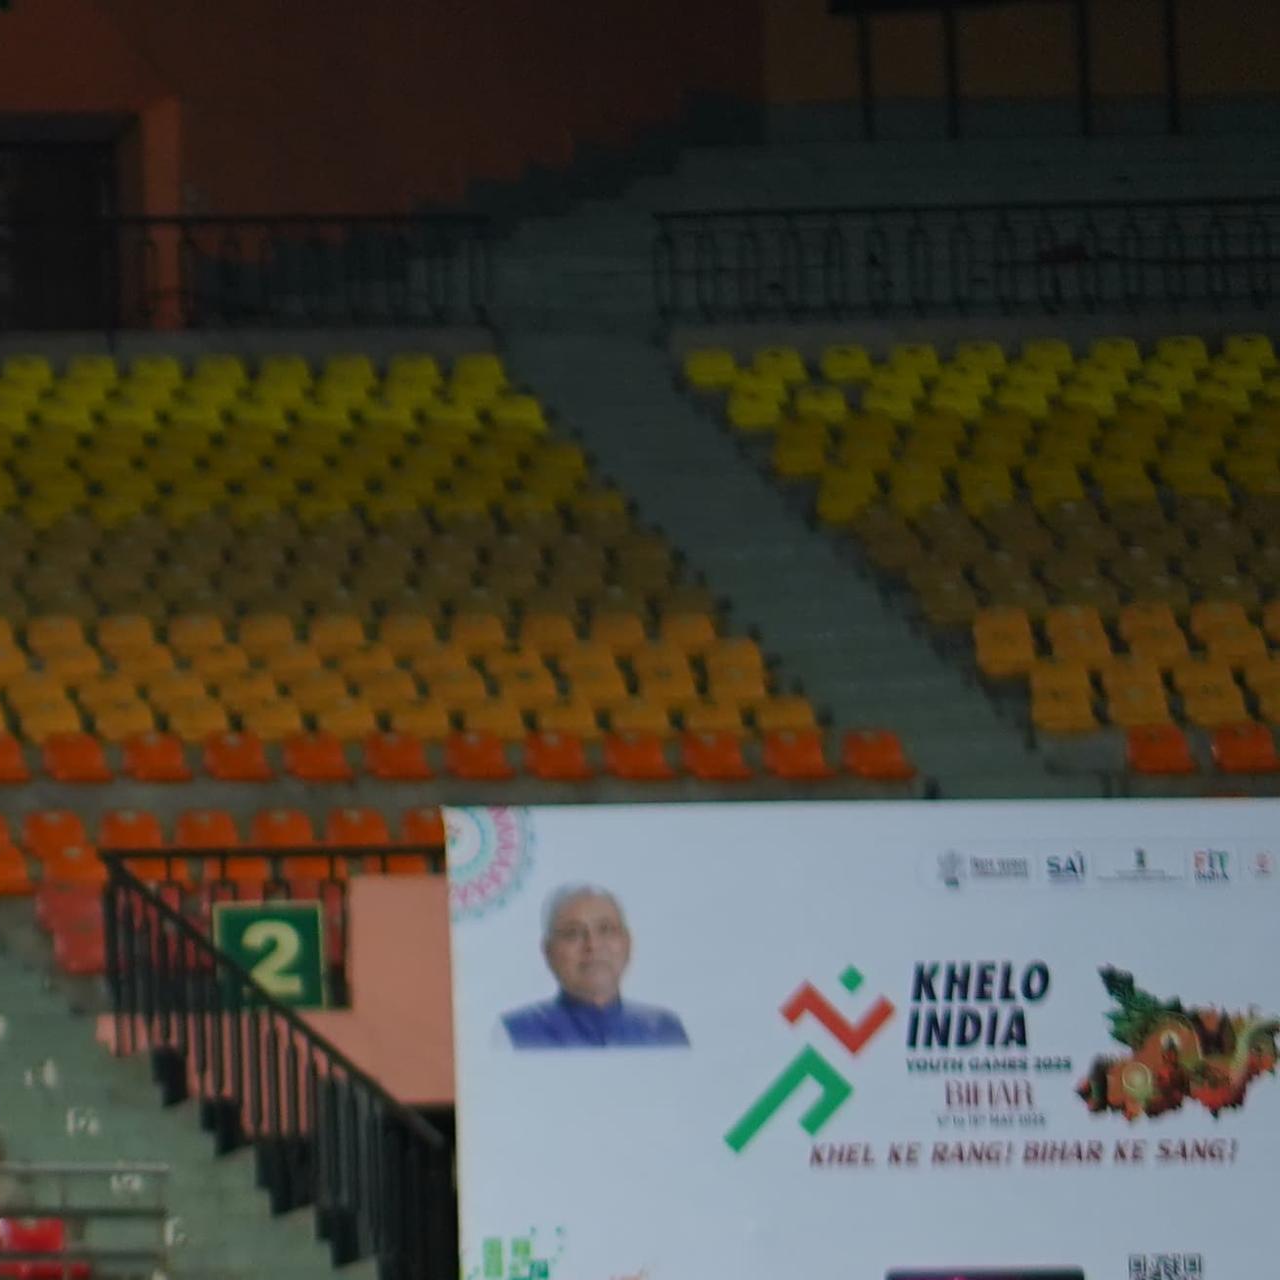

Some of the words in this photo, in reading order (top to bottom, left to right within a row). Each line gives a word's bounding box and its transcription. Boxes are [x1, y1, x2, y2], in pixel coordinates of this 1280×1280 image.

[1047, 853, 1085, 874] SAI
[241, 918, 303, 994] 2
[911, 959, 1050, 1004] KHELO
[906, 1004, 1028, 1049] INDIA
[906, 1057, 963, 1073] YOUTH
[968, 1056, 1028, 1072] GAMES
[1033, 1055, 1072, 1072] 2025
[944, 1079, 1034, 1107] BIHAR
[809, 1144, 875, 1167] KHEL
[887, 1143, 921, 1165] KE
[930, 1141, 1014, 1166] RANG!
[1022, 1139, 1105, 1164] BIHAR
[1113, 1139, 1148, 1162] KE
[1156, 1137, 1238, 1163] SANG!
